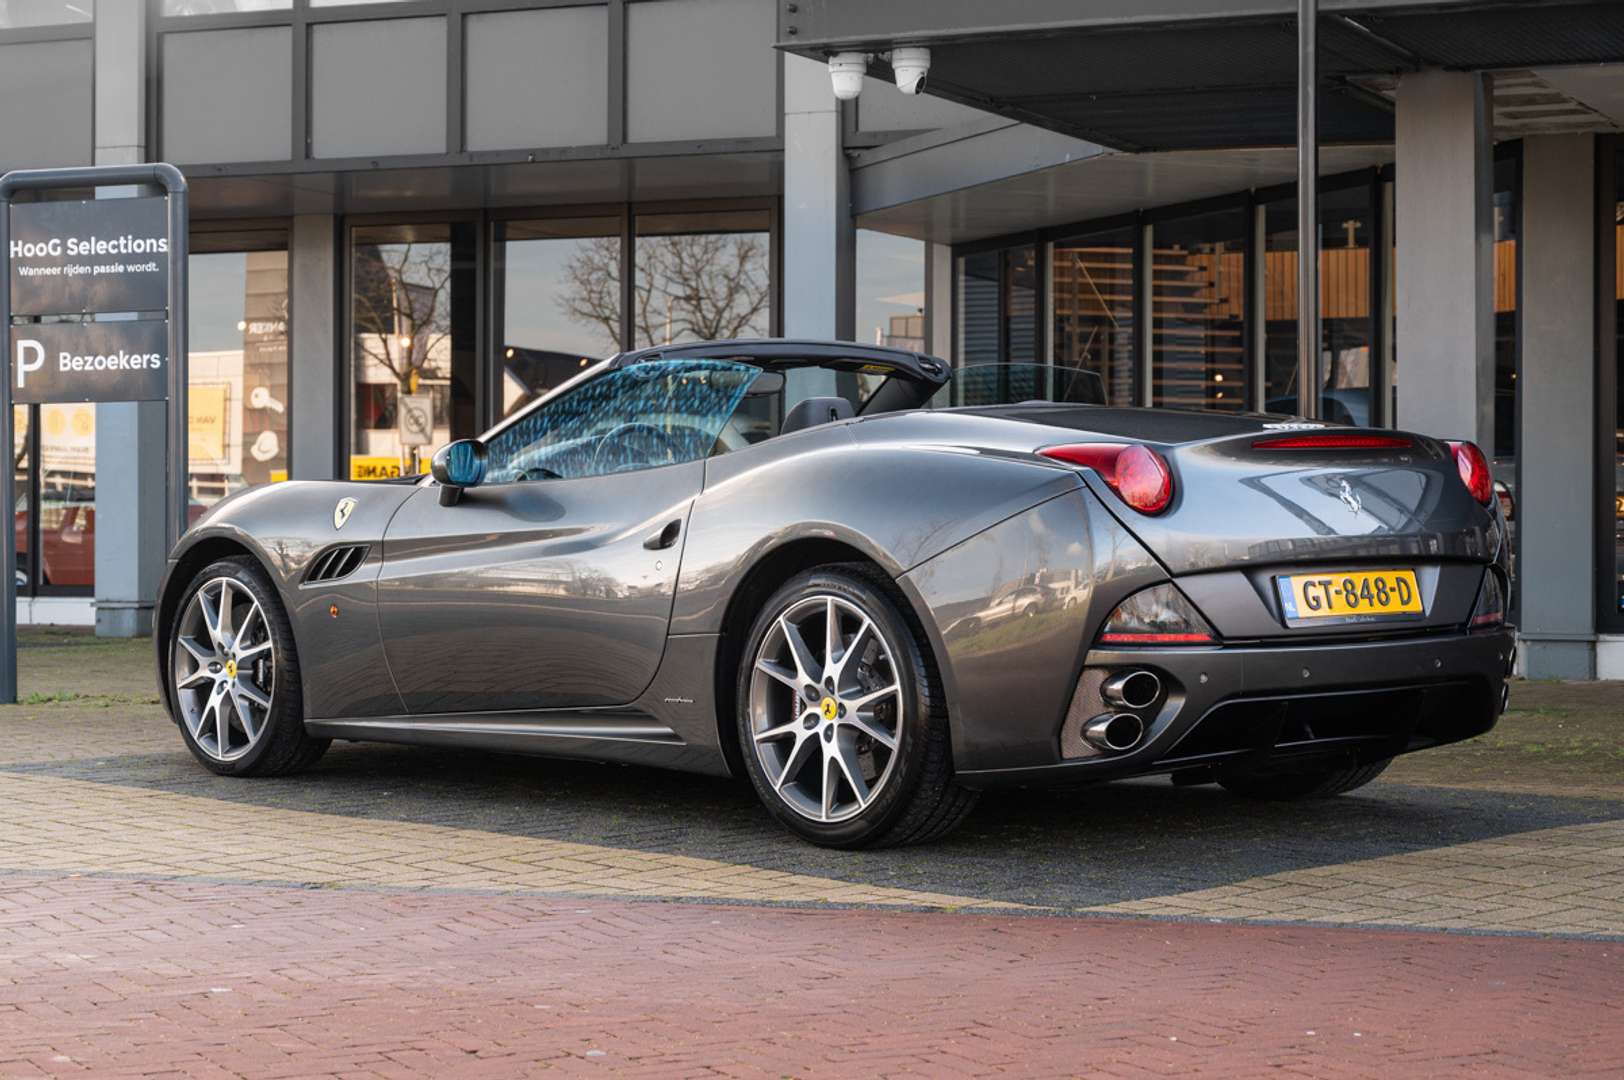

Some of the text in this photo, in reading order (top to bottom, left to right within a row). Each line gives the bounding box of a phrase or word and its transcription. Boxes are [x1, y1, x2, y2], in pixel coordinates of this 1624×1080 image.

[10, 235, 168, 259] HooG Selections
[18, 261, 159, 277] Wanneer rijden passie wordt.
[16, 339, 161, 388] P Bezoekers
[1303, 576, 1412, 611] GT-848-D
